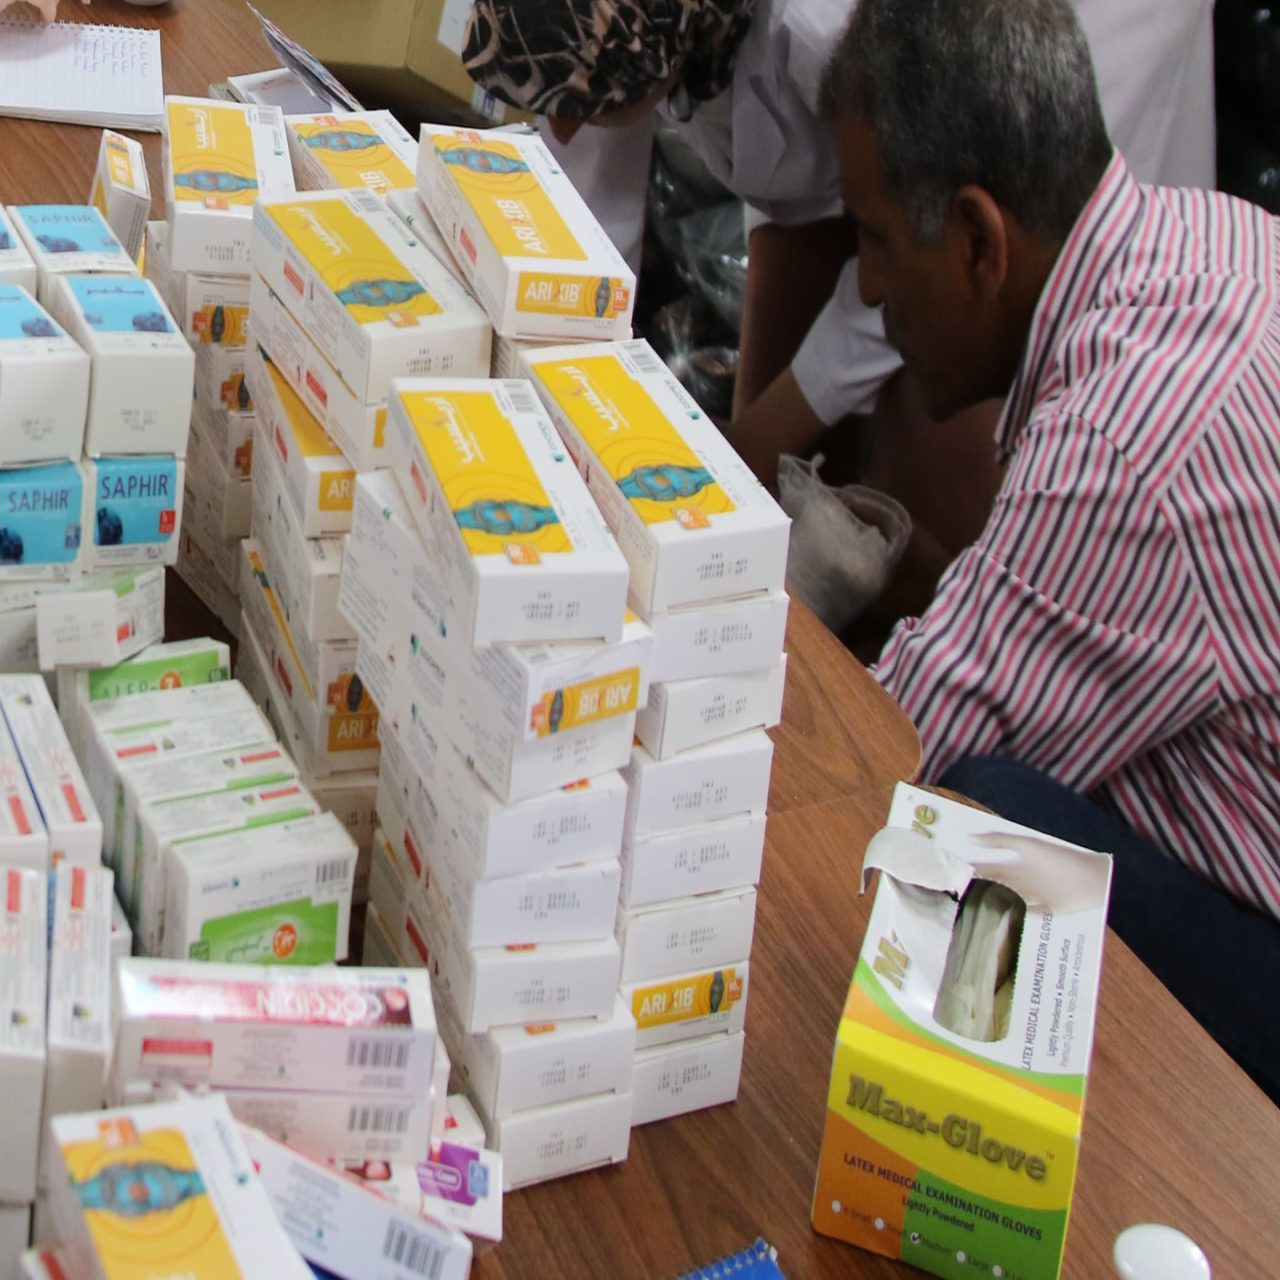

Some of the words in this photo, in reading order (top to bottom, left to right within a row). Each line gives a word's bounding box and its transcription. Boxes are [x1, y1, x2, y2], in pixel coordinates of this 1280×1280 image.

[524, 278, 580, 303] ARIXIB
[9, 488, 70, 513] SAPHIR
[101, 474, 169, 500] SAPHIR
[1040, 910, 1054, 941] GLOVES
[1031, 941, 1049, 1005] EXAMINATION
[639, 985, 695, 1019] ARIXIB
[1050, 997, 1063, 1034] Powdered
[1025, 1003, 1040, 1045] MEDICAL
[1022, 1045, 1035, 1071] LATEX
[846, 1073, 1048, 1181] Max-Glove
[844, 1152, 877, 1175] LATEX
[877, 1166, 923, 1194] MEDICAL
[926, 1185, 1000, 1223] EXAMINATION
[1001, 1216, 1043, 1241] GLOVES
[932, 1207, 975, 1232] Powdered
